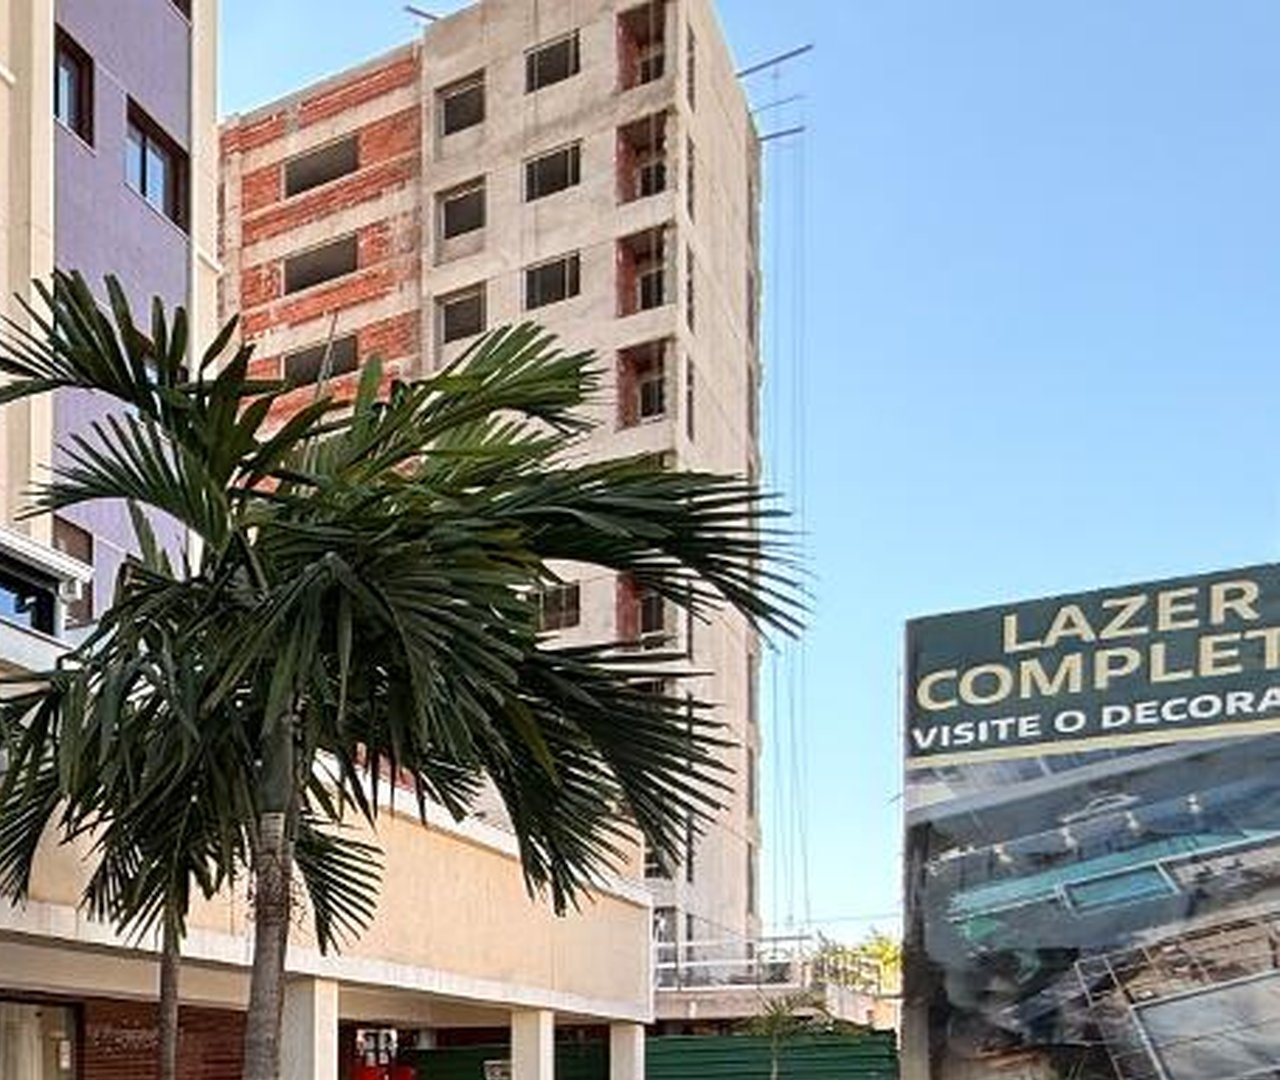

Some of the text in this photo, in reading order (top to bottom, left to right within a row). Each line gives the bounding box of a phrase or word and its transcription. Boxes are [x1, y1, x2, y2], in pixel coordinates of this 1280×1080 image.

[1003, 580, 1260, 652] LAZER
[913, 714, 1041, 749] VISITE
[1054, 711, 1086, 733] O
